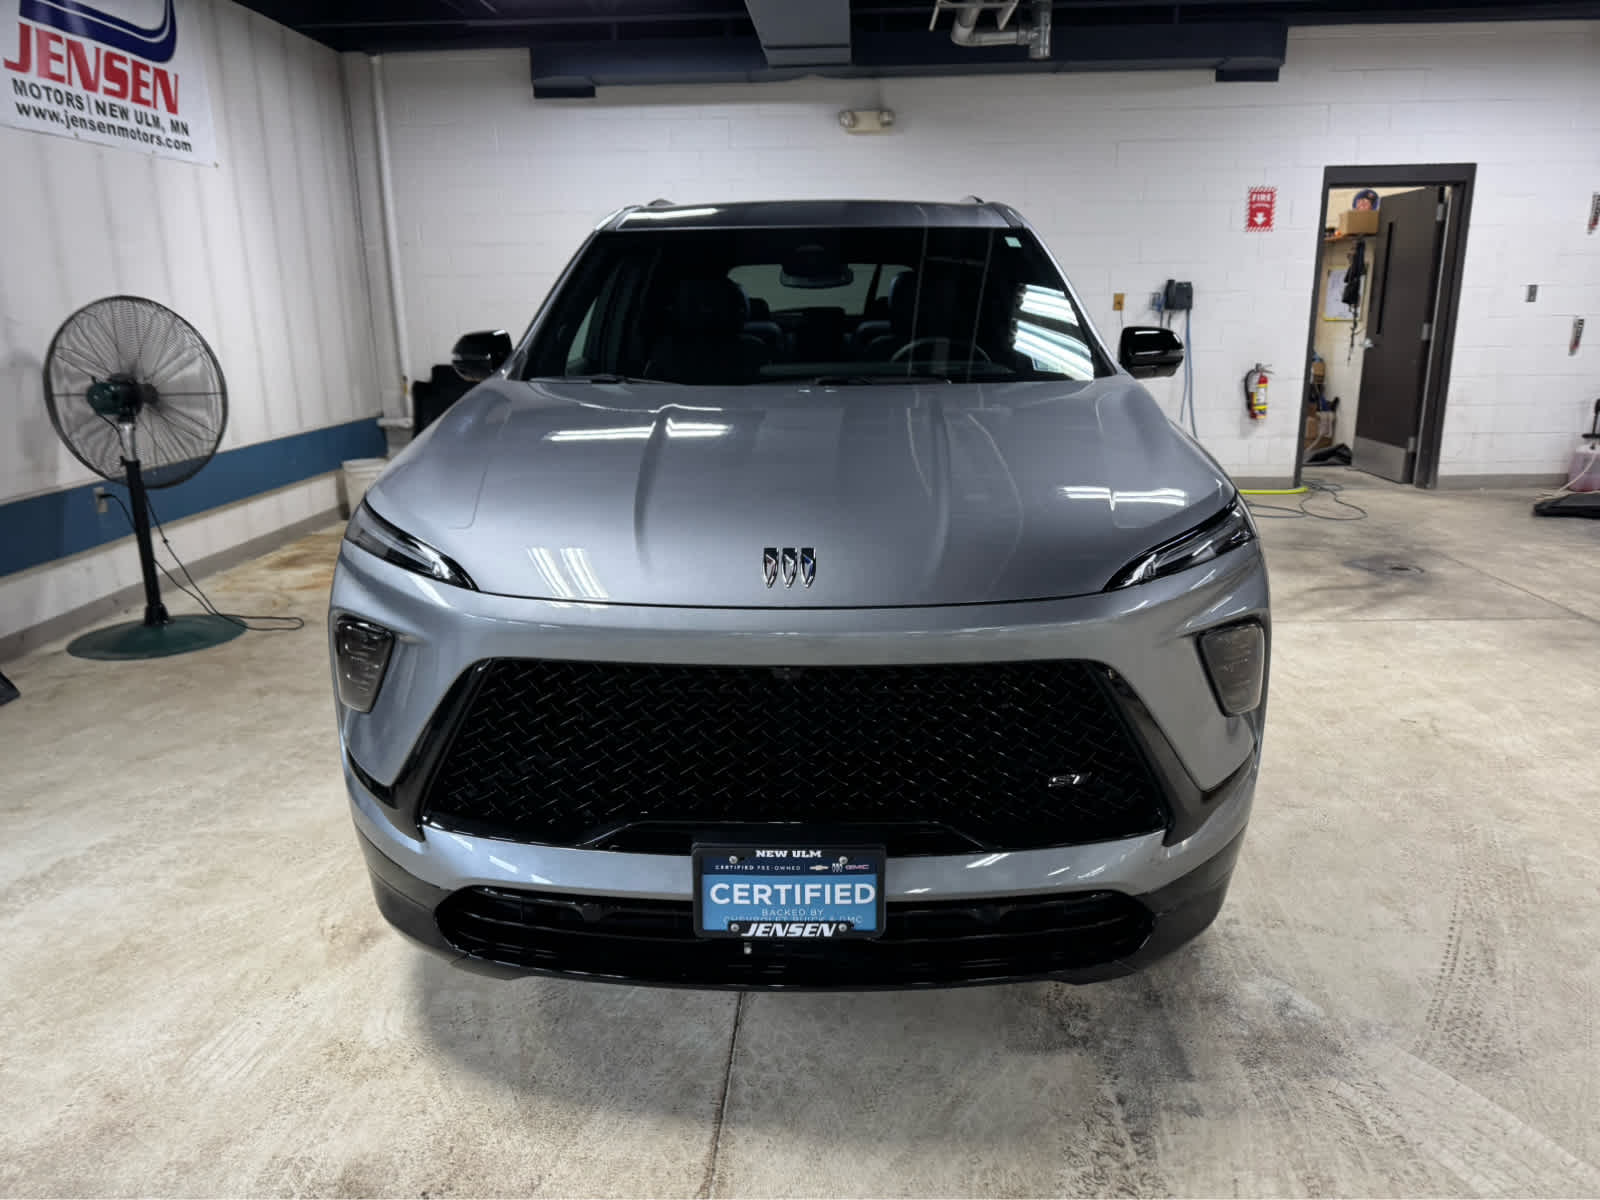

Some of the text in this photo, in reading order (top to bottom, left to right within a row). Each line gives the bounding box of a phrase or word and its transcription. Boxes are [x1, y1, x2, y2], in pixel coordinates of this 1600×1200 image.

[3, 21, 178, 115] JENSEN
[12, 78, 189, 136] MOTORS NEW ULM, MN
[15, 102, 192, 152] www.jensenmotors.com
[1252, 192, 1272, 202] FIRE
[755, 849, 822, 858] NEW ULM
[709, 883, 876, 905] CERTIFIED
[761, 908, 825, 916] BACKED BY
[741, 923, 837, 937] JENSEN
